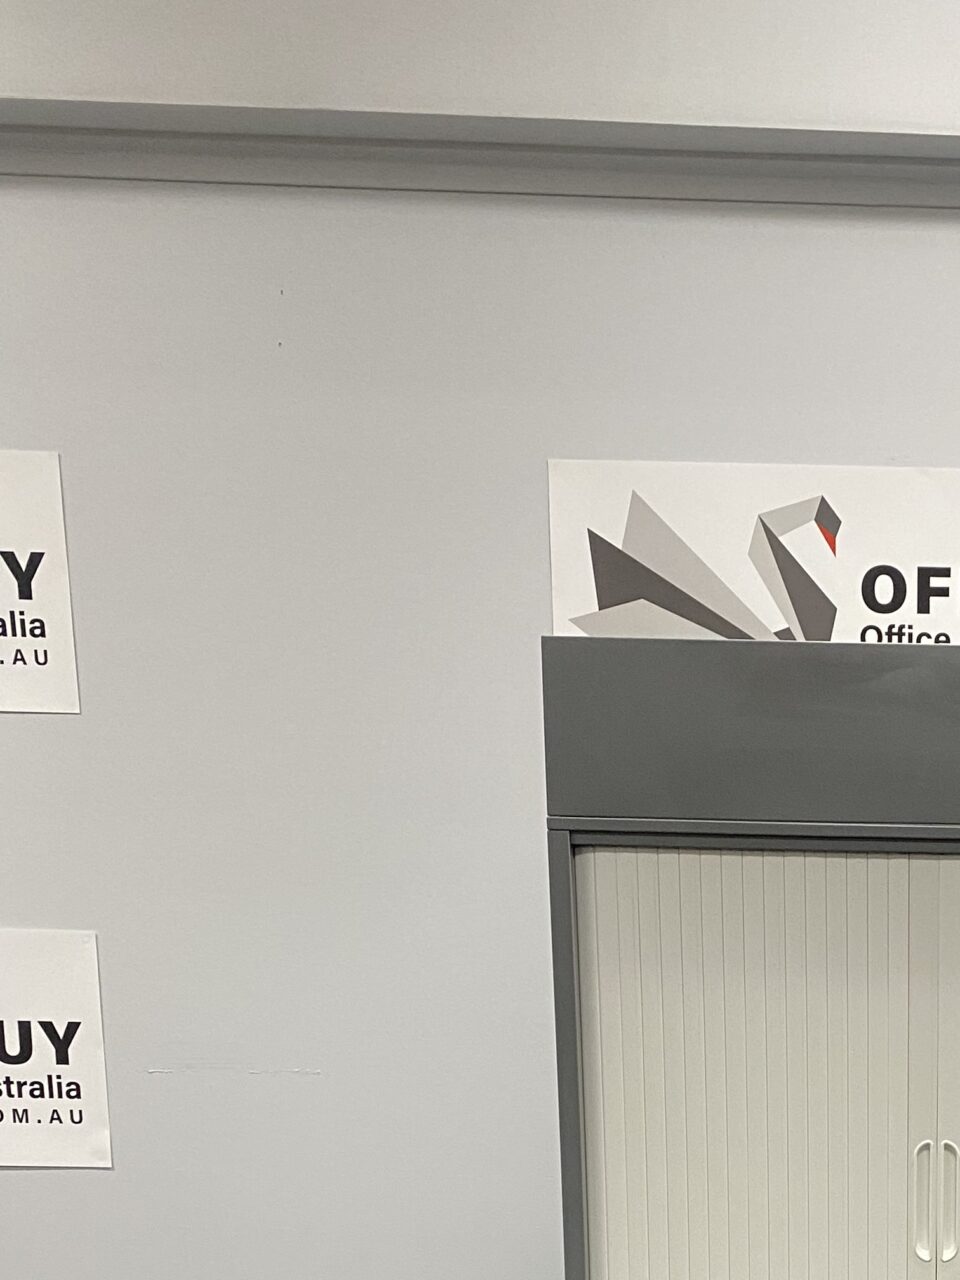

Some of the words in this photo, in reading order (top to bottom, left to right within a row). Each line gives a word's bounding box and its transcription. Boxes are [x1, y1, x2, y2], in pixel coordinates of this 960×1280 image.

[860, 623, 951, 645] Office
[0, 1074, 82, 1099] tralia
[0, 1108, 84, 1125] M.AU
